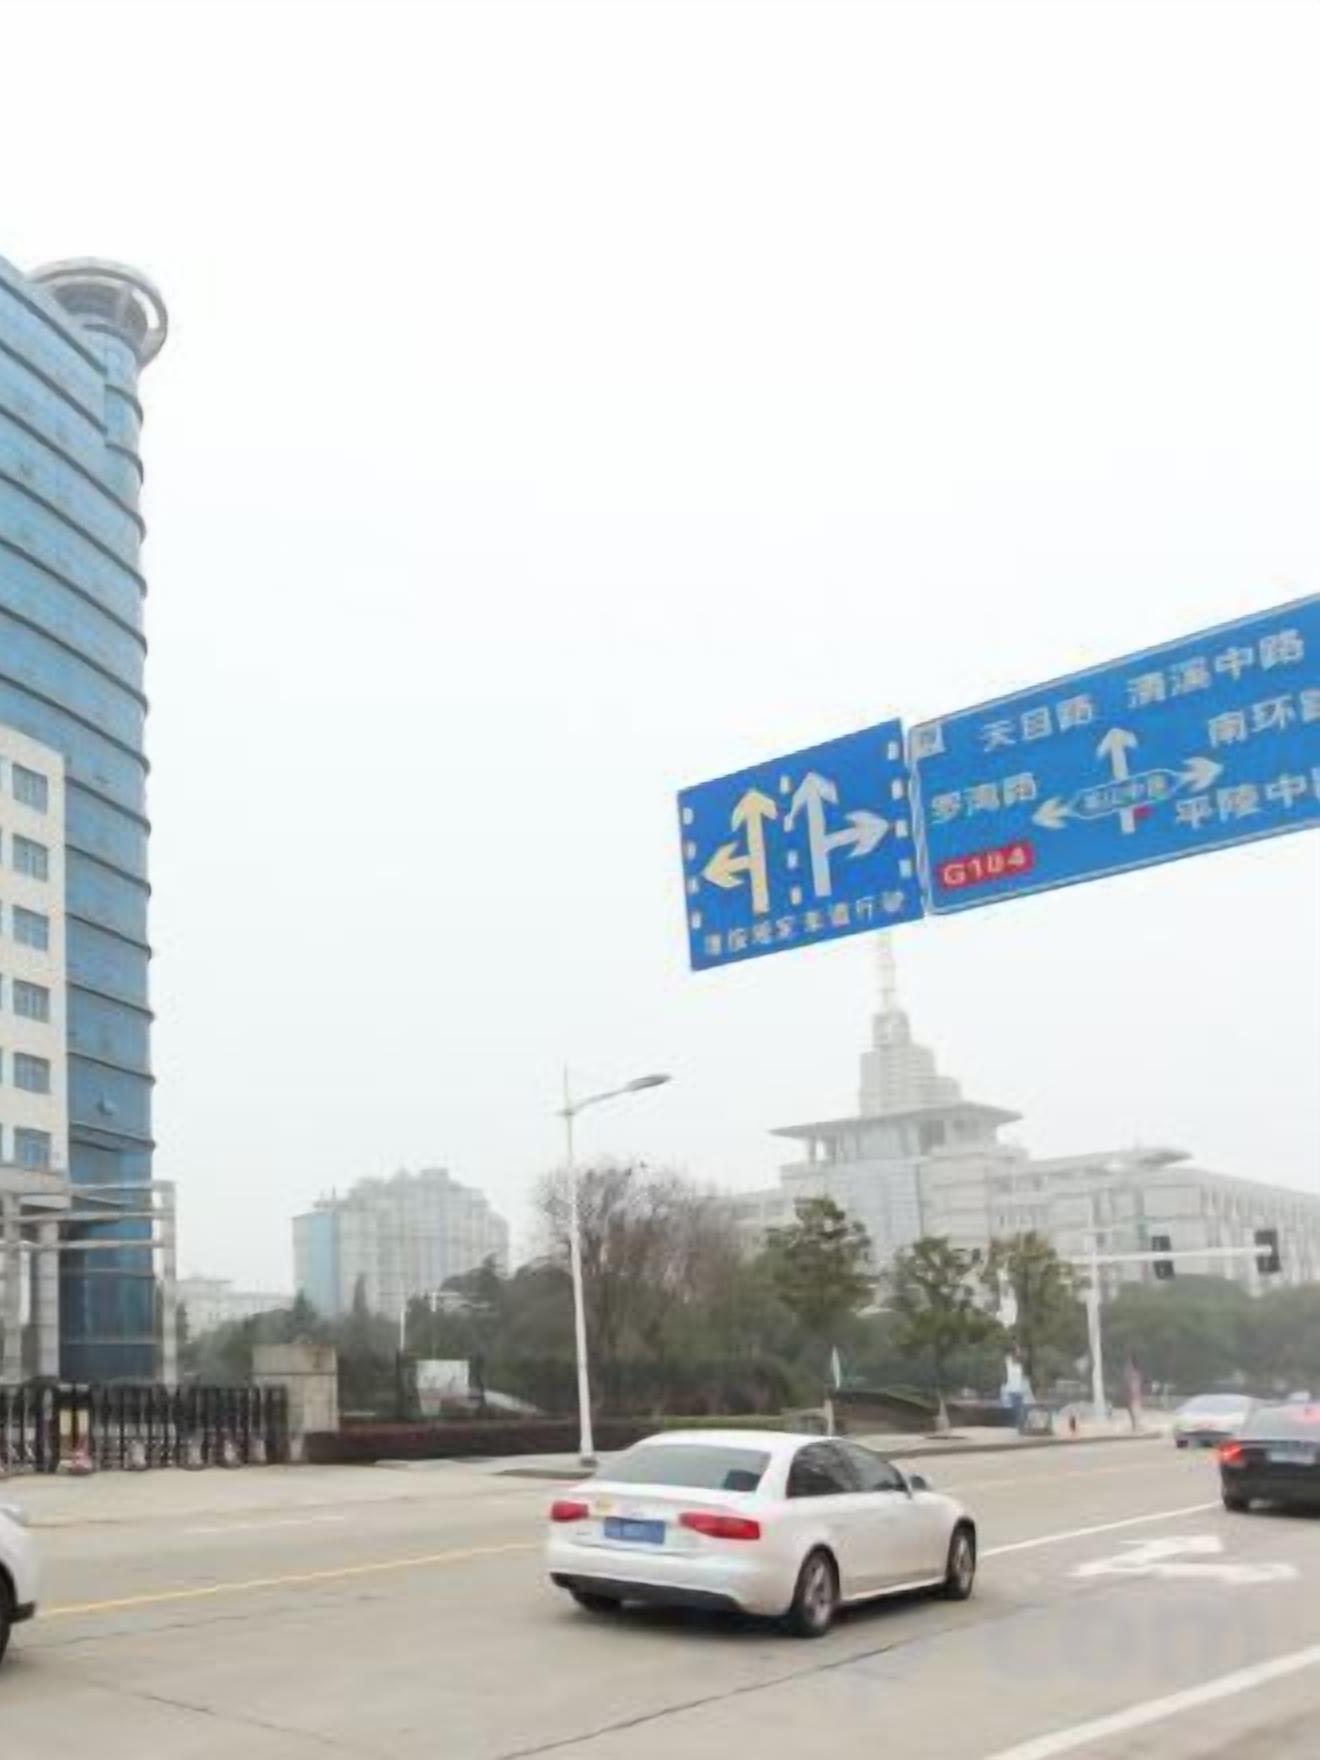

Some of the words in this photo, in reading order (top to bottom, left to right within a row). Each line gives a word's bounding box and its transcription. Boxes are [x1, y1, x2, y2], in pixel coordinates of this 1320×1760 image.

[1176, 768, 1320, 829] 平陵中
[943, 847, 1026, 886] G104
